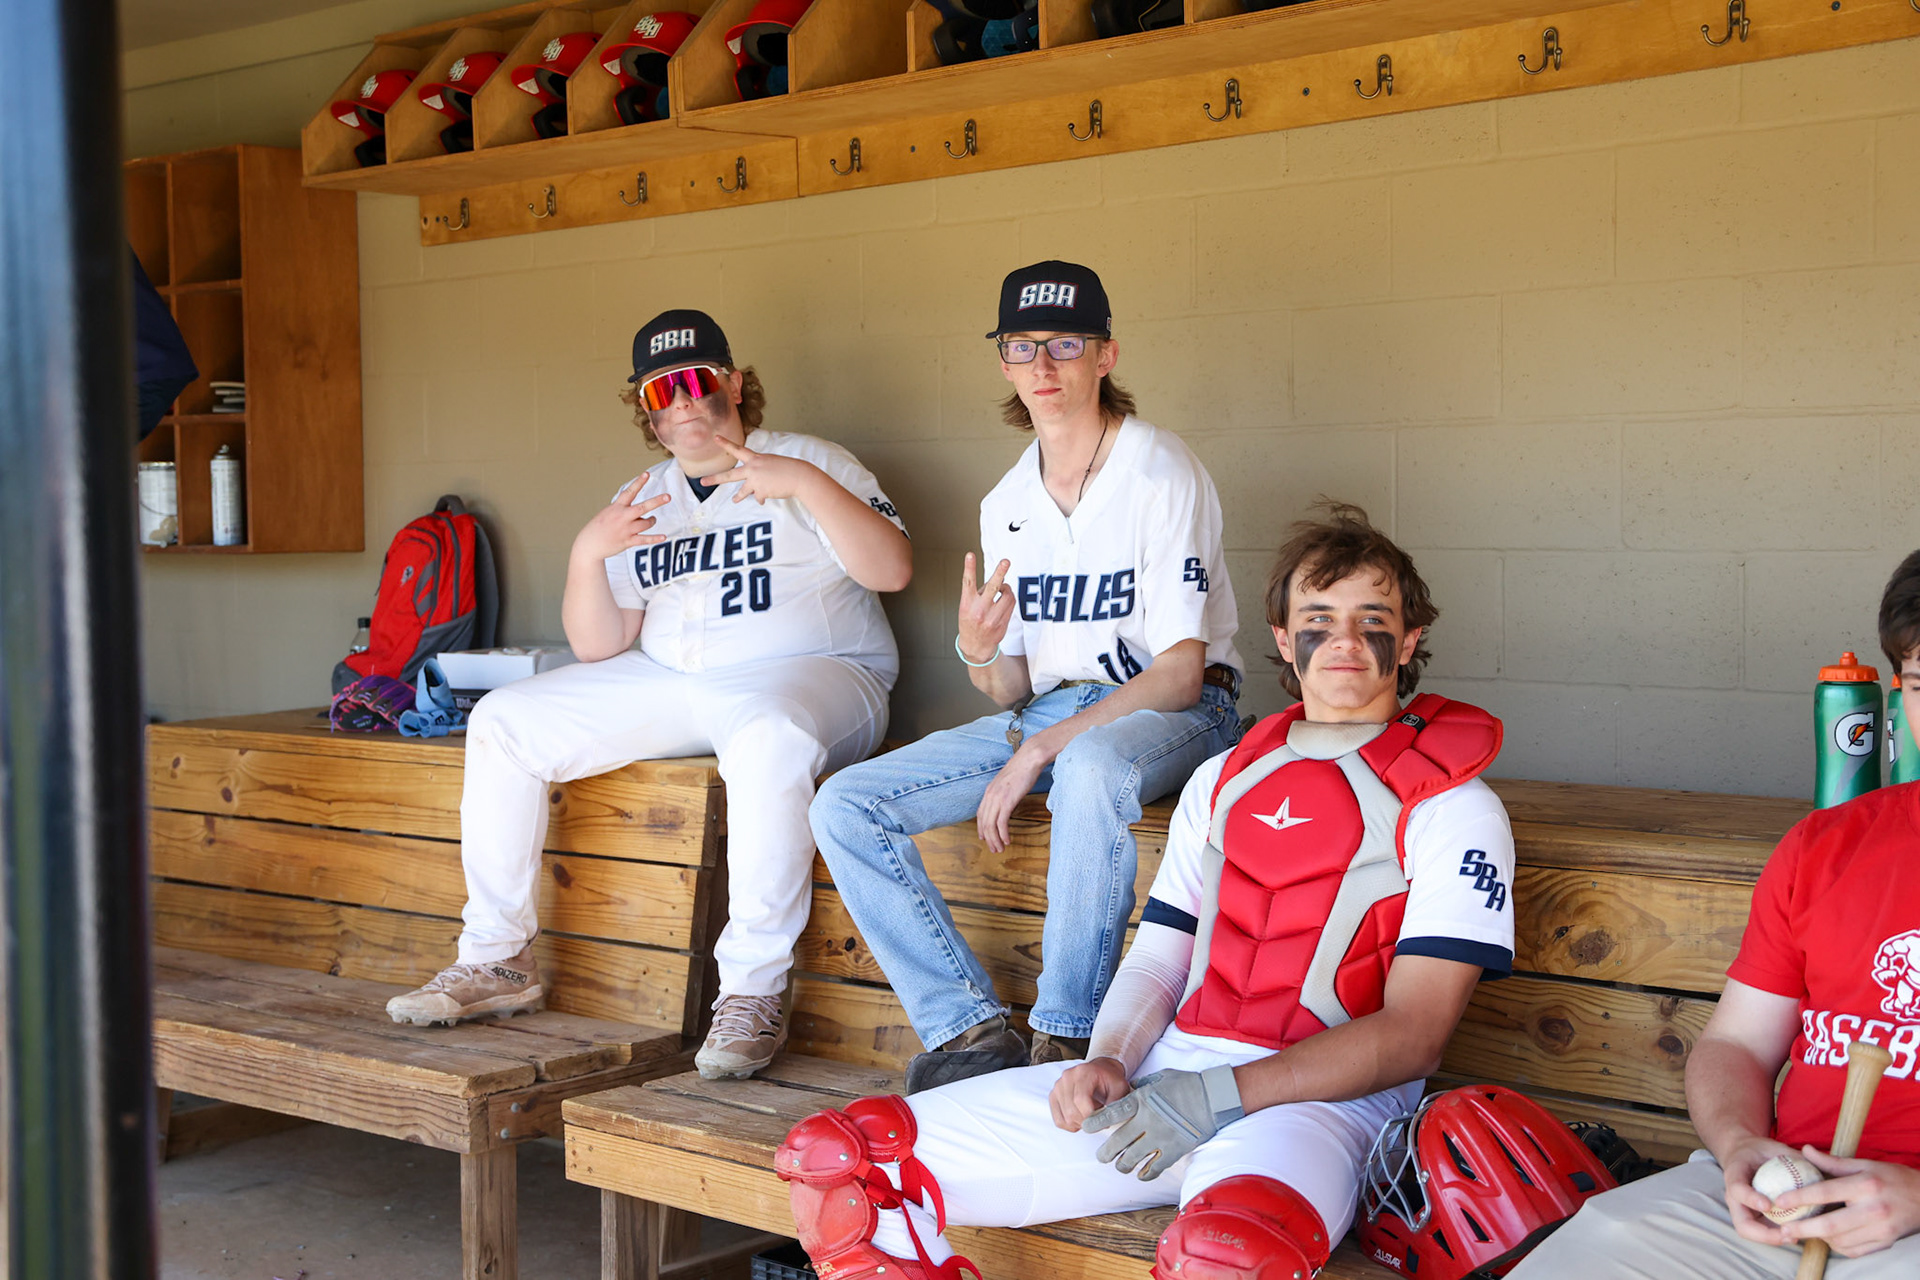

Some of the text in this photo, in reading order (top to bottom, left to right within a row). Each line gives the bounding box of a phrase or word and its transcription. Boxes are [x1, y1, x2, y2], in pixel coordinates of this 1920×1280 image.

[1018, 281, 1078, 311] SBA
[649, 326, 697, 357] SBA
[634, 520, 773, 589] EAGLES
[721, 568, 772, 617] 20
[1018, 568, 1135, 622] EGLES
[1097, 636, 1143, 685] 18
[1834, 711, 1875, 757] G
[1459, 849, 1506, 913] SBA
[491, 966, 528, 984] ADIZERO
[1802, 1010, 1920, 1081] BASEB
